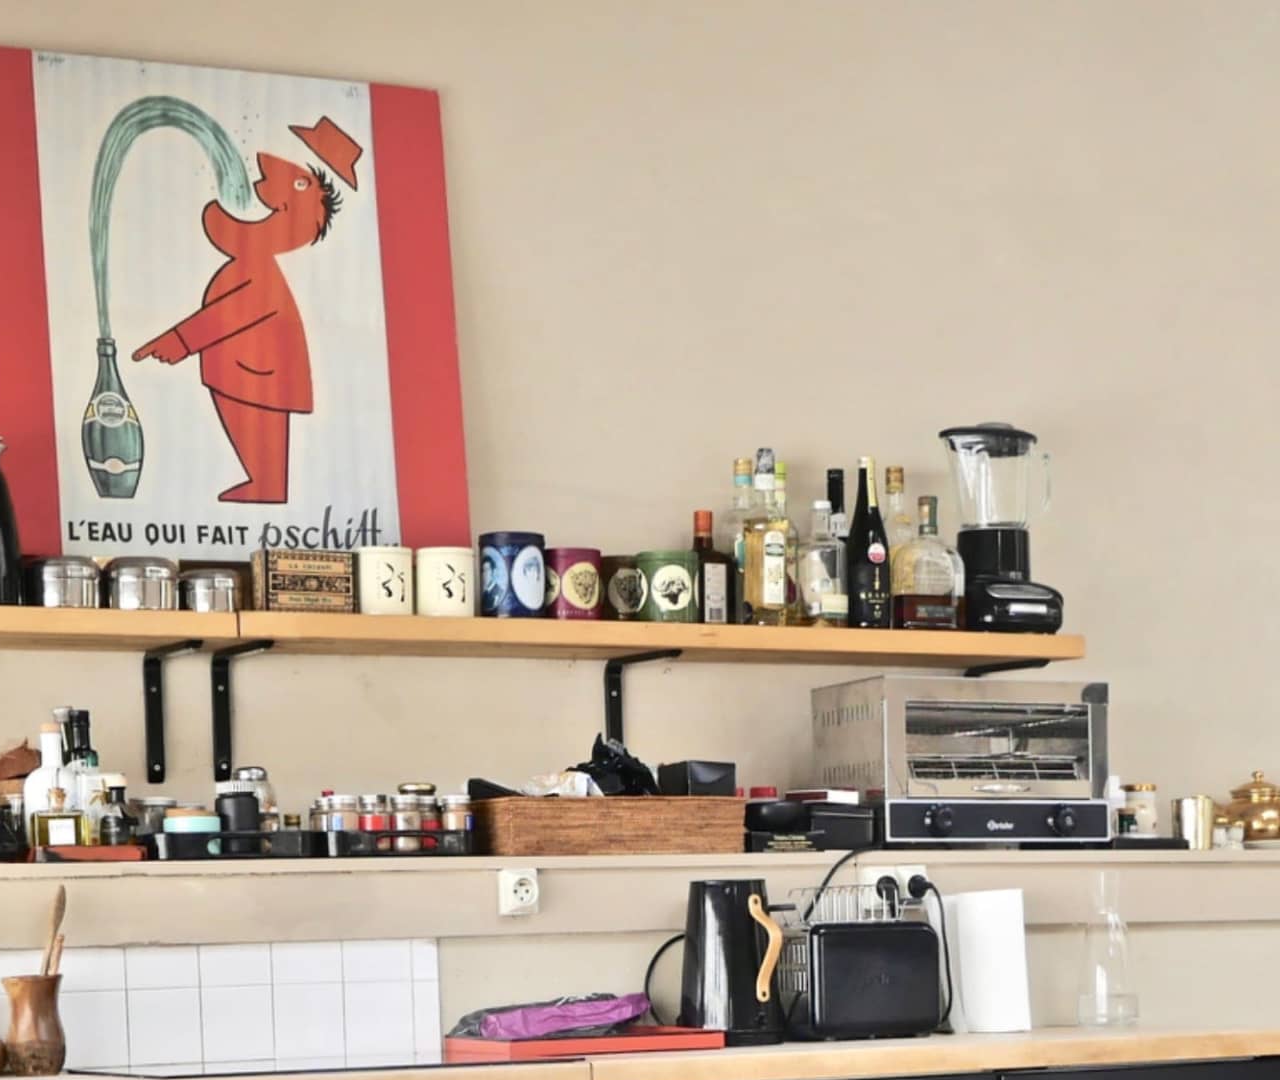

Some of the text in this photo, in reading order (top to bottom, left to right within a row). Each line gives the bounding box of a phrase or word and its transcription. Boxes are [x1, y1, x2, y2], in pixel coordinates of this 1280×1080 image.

[68, 520, 133, 543] L'EAU
[144, 523, 186, 546] QUI
[197, 525, 249, 545] FAIT
